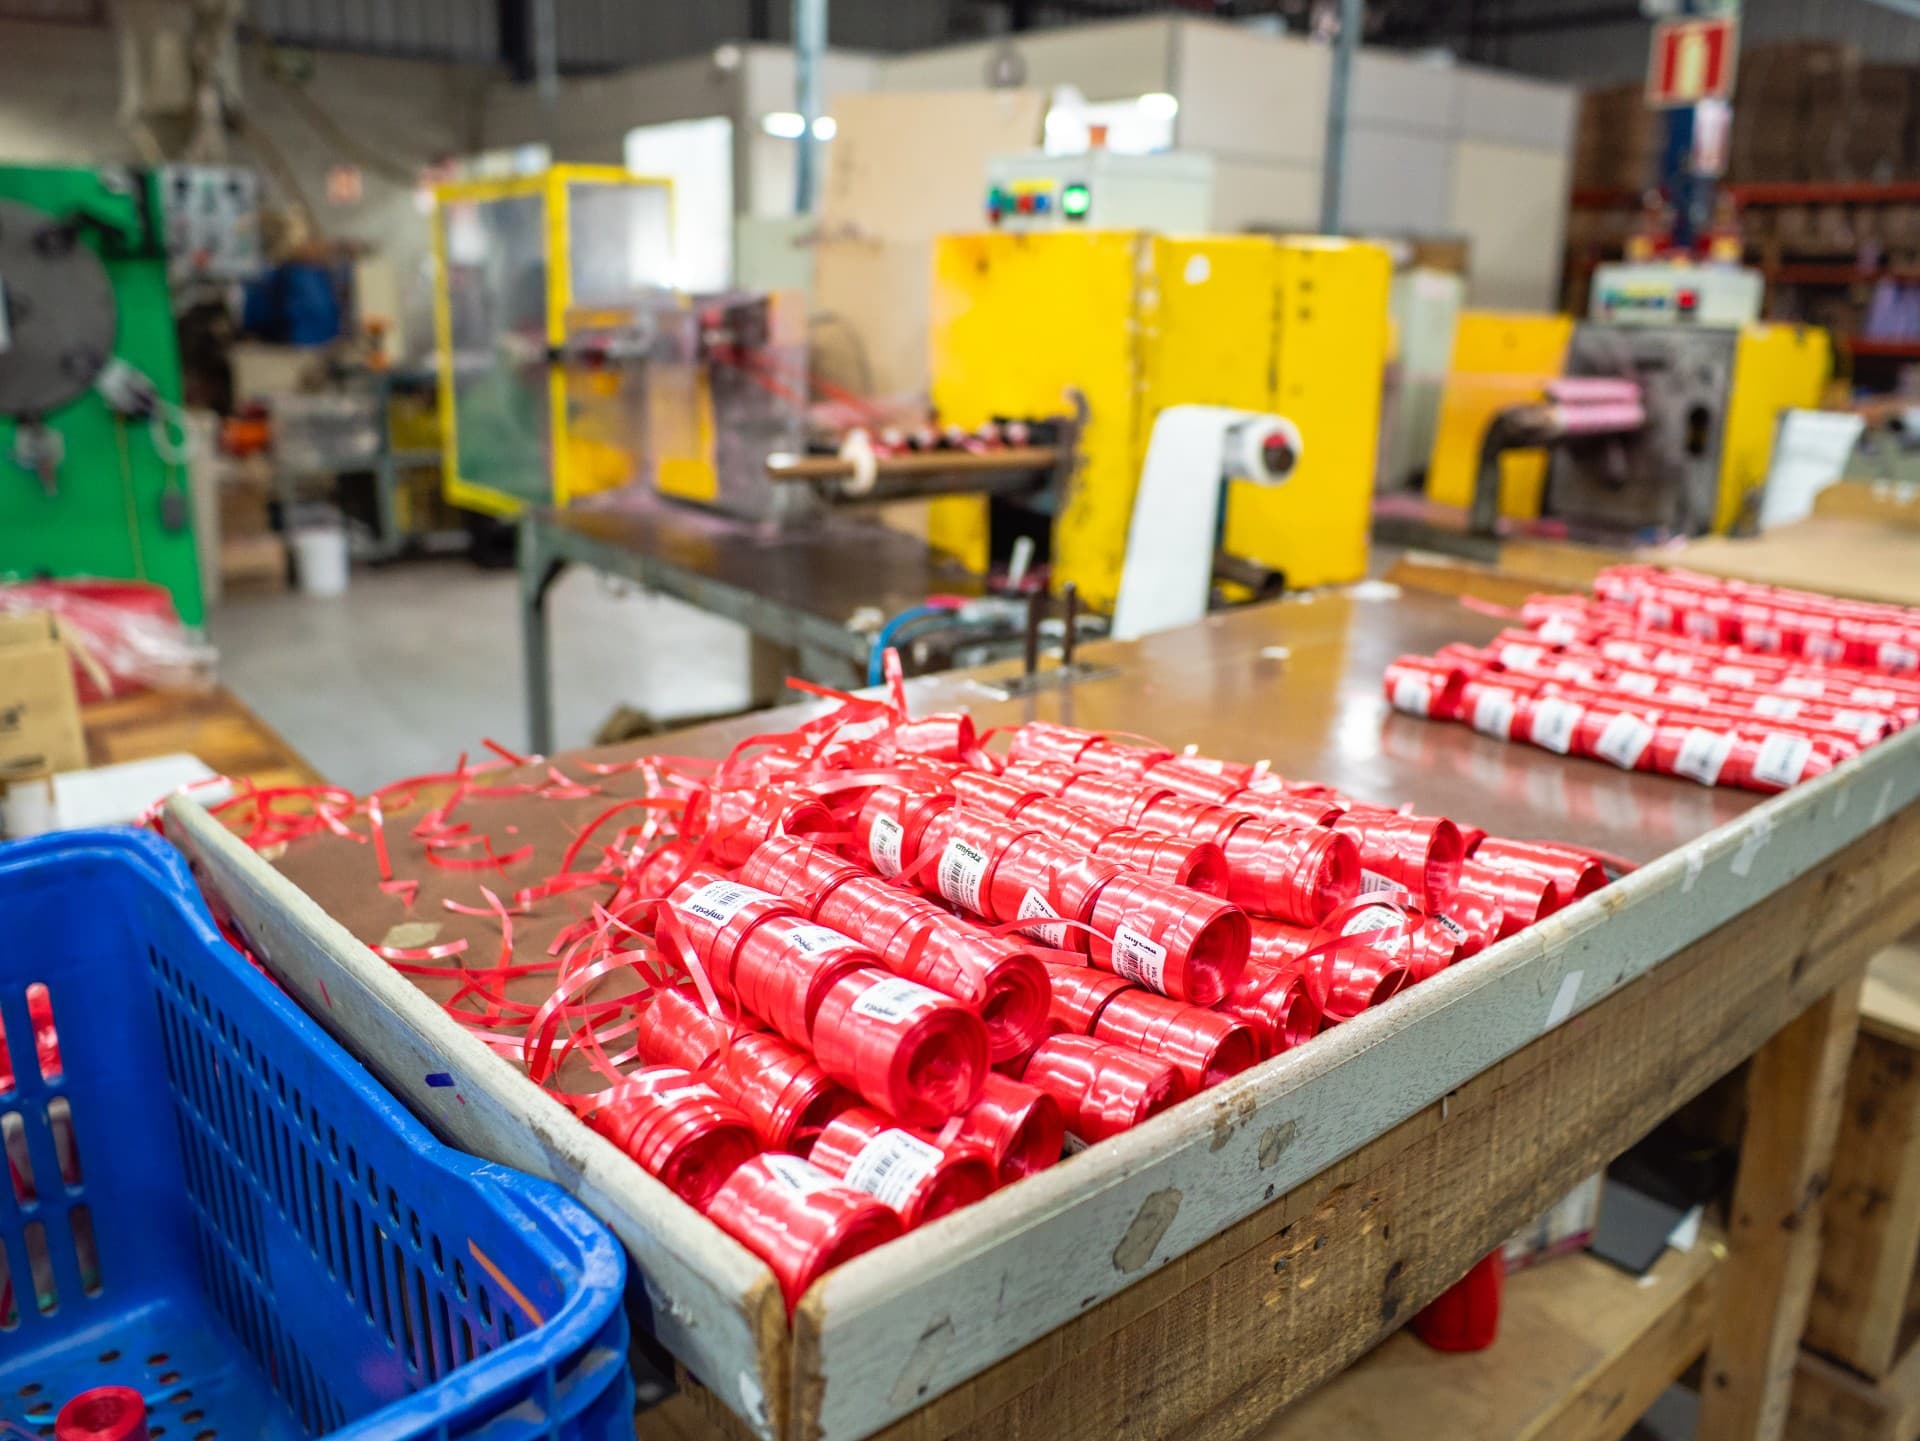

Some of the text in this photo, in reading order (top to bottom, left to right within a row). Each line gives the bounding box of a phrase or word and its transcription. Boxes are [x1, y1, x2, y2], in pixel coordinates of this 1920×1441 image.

[956, 843, 982, 864] emfesta
[692, 904, 724, 921] emfesta
[1434, 913, 1460, 935] festa
